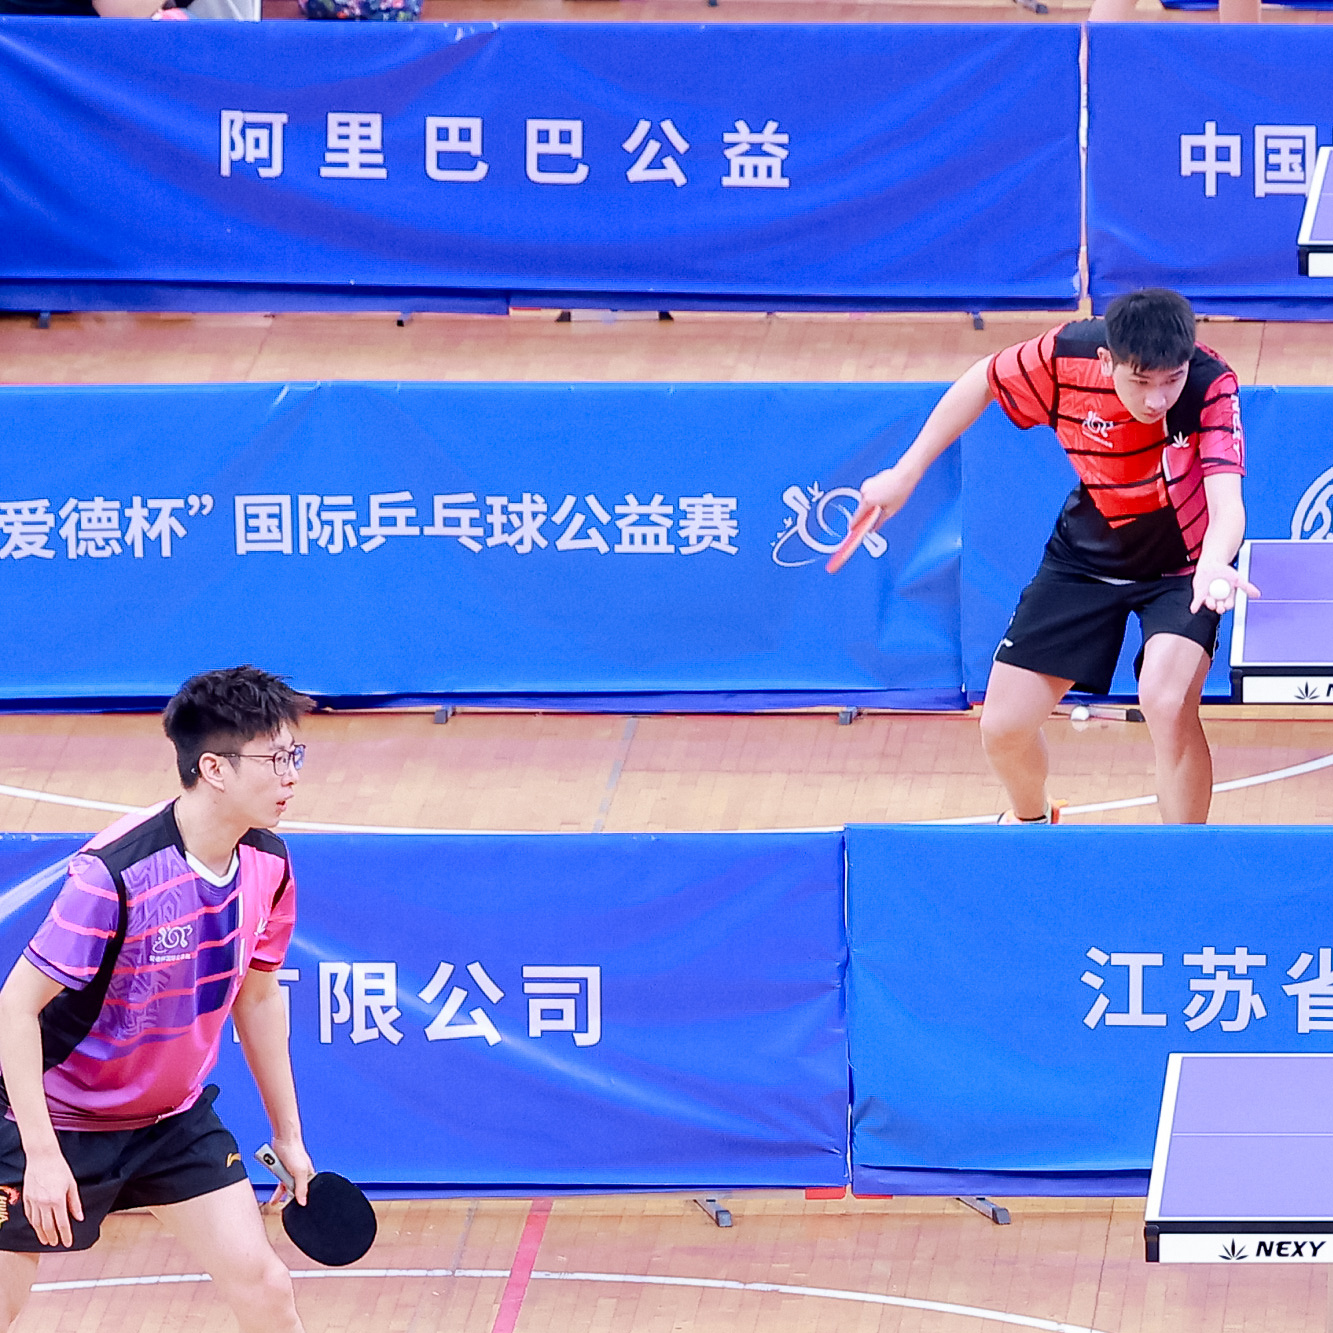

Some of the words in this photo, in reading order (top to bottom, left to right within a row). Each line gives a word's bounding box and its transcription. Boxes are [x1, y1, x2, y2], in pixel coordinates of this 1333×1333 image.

[219, 109, 793, 189] 阿里巴巴公益
[1255, 1239, 1326, 1258] NEXY
